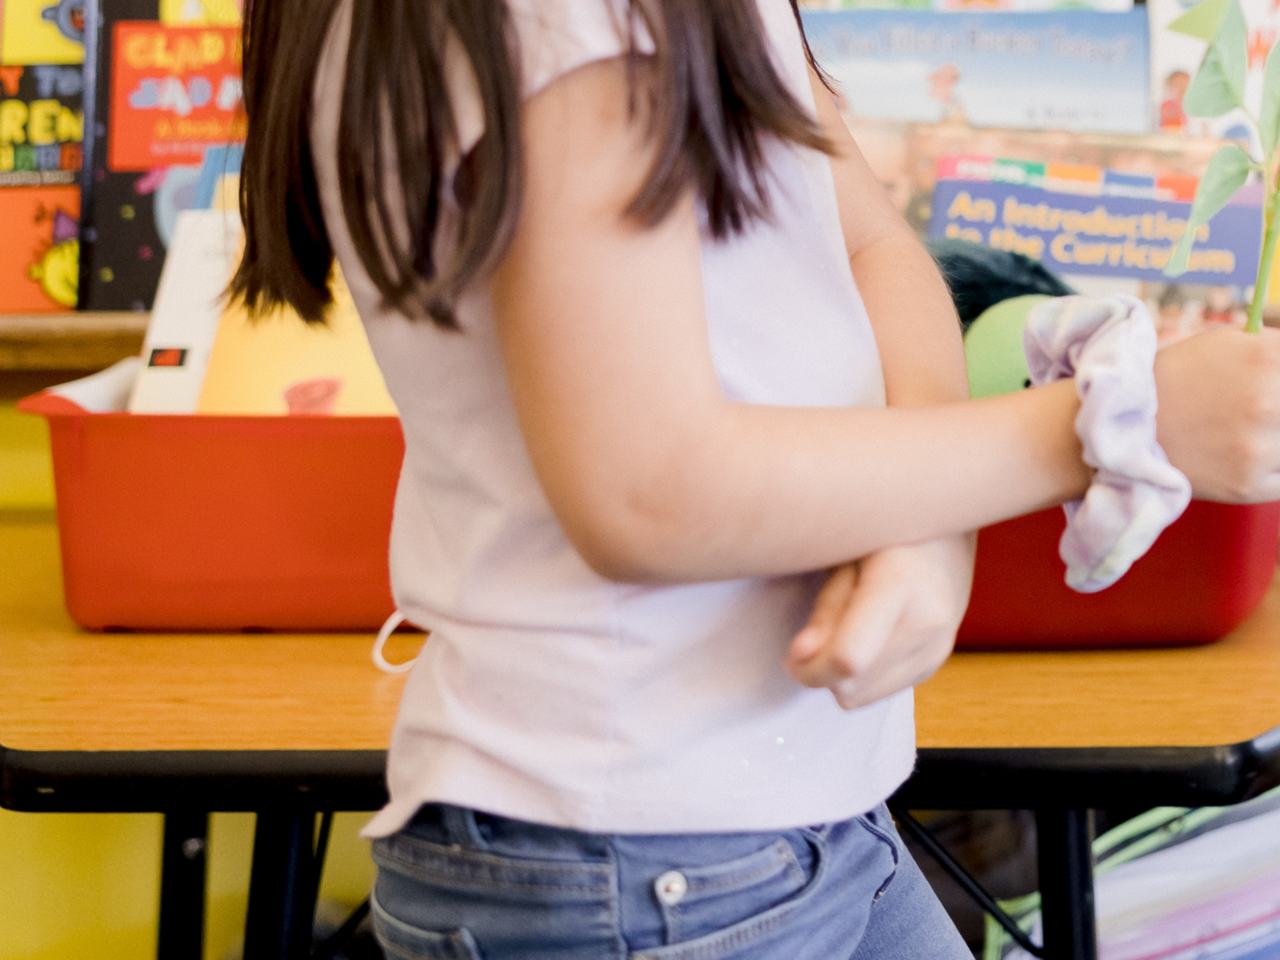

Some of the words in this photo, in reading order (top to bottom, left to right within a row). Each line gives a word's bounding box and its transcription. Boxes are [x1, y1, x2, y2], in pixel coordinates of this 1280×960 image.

[947, 191, 997, 224] An
[1003, 196, 1211, 245] Introduction
[989, 227, 1046, 261] the
